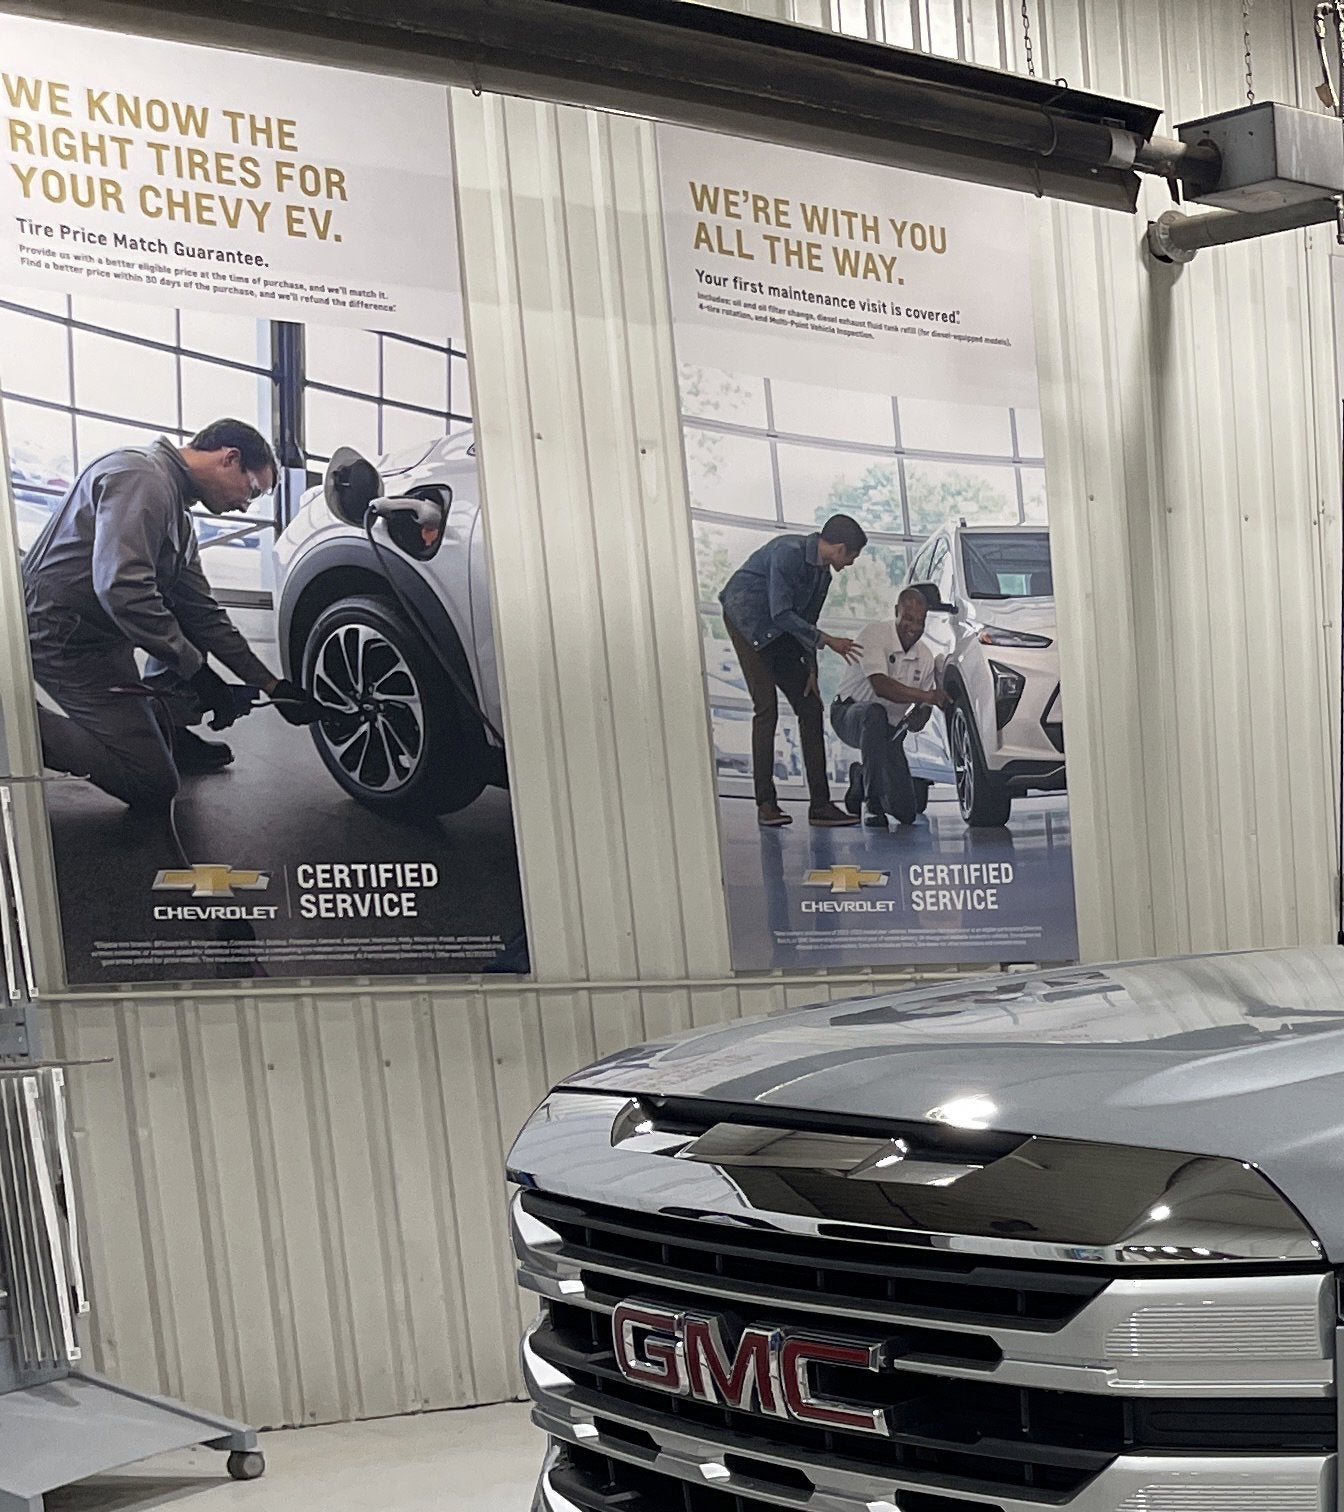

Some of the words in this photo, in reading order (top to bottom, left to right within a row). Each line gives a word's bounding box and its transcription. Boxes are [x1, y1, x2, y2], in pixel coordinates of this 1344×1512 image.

[2, 72, 73, 118] WE
[87, 89, 209, 139] KNOW
[222, 109, 298, 153] THE
[8, 117, 134, 170] RIGHT
[146, 141, 261, 188] TIRES
[275, 162, 348, 202] FOR
[9, 162, 125, 215] YOUR
[139, 184, 272, 235] CHEVY
[285, 205, 343, 243] EV.
[689, 181, 792, 229] WE'RE
[799, 202, 881, 245] WITH
[889, 217, 947, 255] YOU
[16, 217, 54, 238] Tire
[60, 224, 107, 246] Price
[113, 232, 168, 254] Match
[174, 241, 269, 268] Guarantee.
[693, 221, 755, 261] ALL
[763, 234, 824, 273] THE
[831, 246, 905, 286] WAY.
[18, 244, 56, 258] Provide
[59, 252, 70, 260] us
[74, 253, 95, 264] with
[105, 257, 135, 269] better
[138, 263, 171, 275] eligible
[174, 268, 198, 280] price
[200, 271, 209, 280] at
[212, 272, 226, 281] the
[229, 274, 249, 283] time
[252, 277, 261, 285] of
[263, 279, 307, 291] purchase,
[309, 284, 325, 293] and
[327, 286, 347, 295] we'll
[350, 289, 377, 298] match
[379, 290, 389, 299] it.
[20, 257, 42, 269] Find
[53, 262, 84, 274] better
[86, 267, 110, 278] price
[114, 271, 143, 282] within
[146, 275, 157, 284] 30
[160, 277, 181, 288] days
[183, 280, 193, 288] of
[195, 282, 210, 291] the
[213, 284, 257, 298] purchase,
[259, 290, 275, 299] and
[278, 292, 298, 301] we'll
[300, 294, 329, 305] refund
[332, 298, 346, 307] the
[695, 268, 728, 289] Your
[732, 275, 764, 296] first
[767, 284, 856, 311] maintenance
[859, 298, 887, 316] visit
[891, 302, 902, 317] is
[296, 862, 439, 890] CERTIFIED
[909, 862, 1014, 886] CERTIFIED
[153, 906, 279, 921] CHEVROLET
[299, 892, 419, 919] SERVICE
[800, 900, 896, 913] CHEVROLET
[911, 888, 1000, 912] SERVICE
[611, 1299, 890, 1438] GMC
